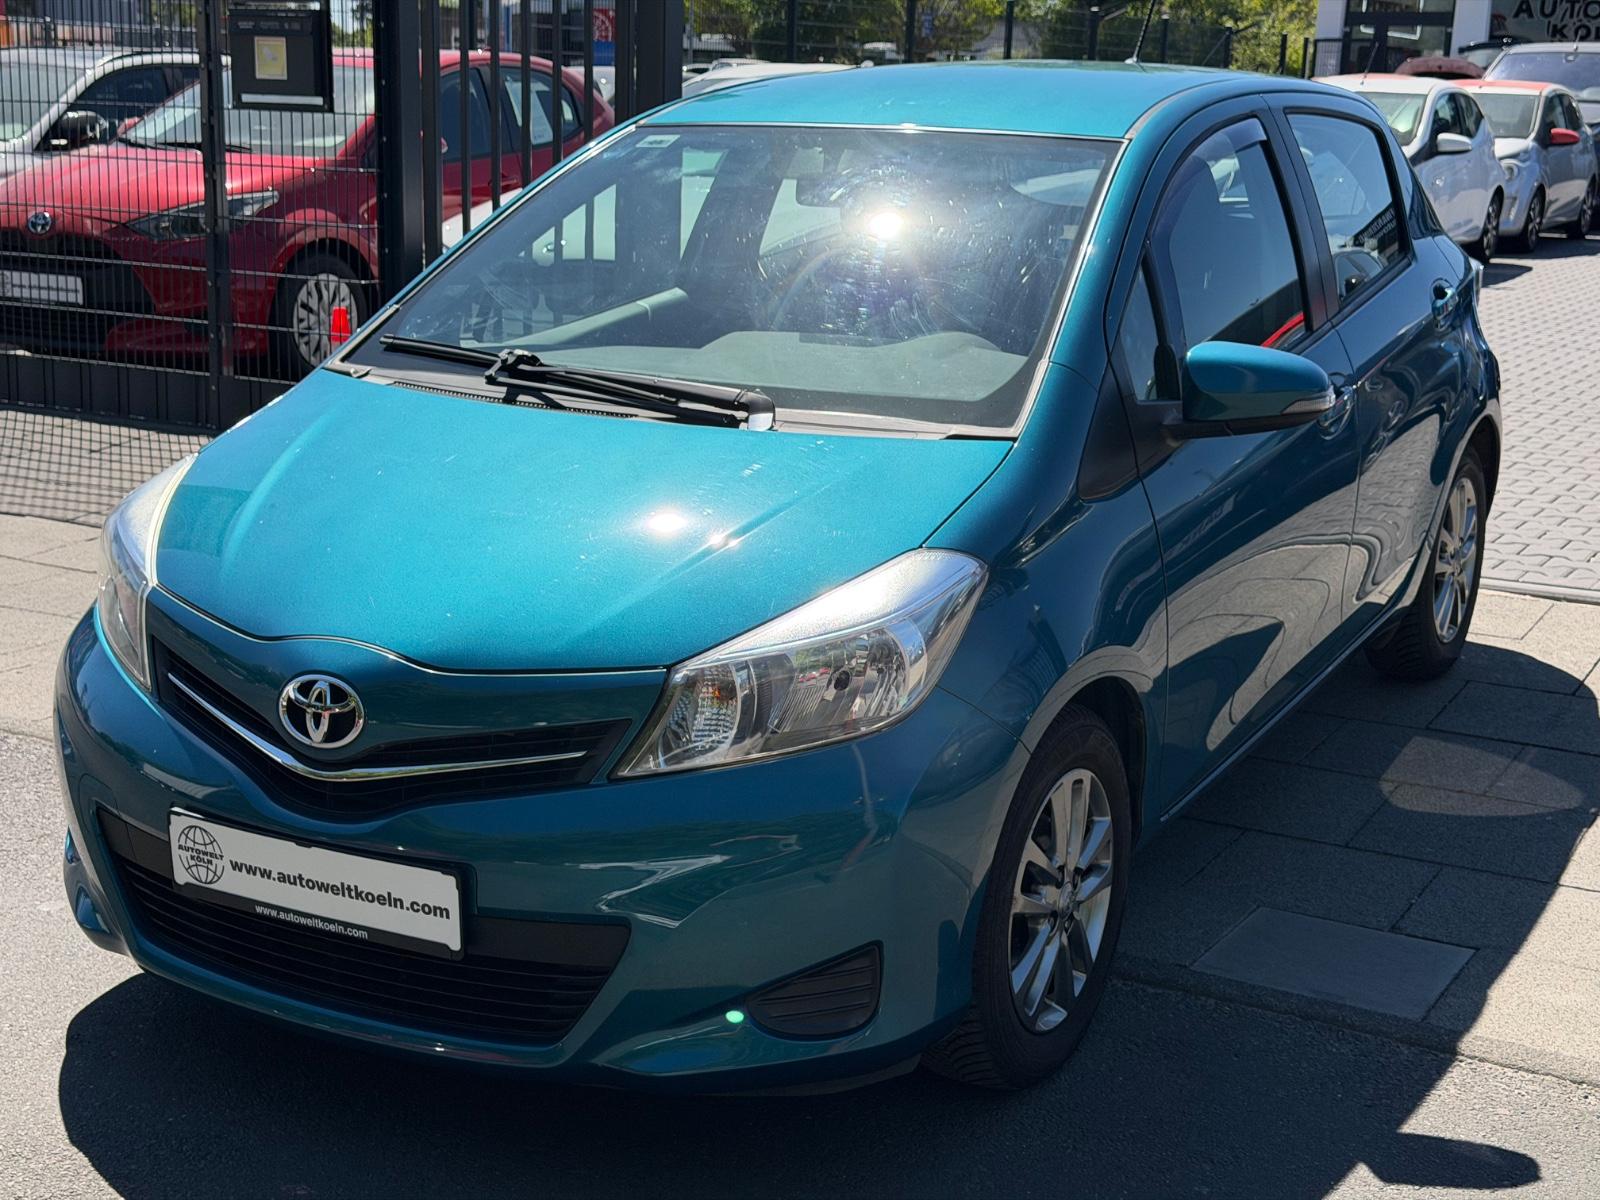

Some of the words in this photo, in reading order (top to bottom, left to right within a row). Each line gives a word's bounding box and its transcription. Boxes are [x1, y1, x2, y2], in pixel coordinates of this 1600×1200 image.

[178, 844, 224, 861] AUTOWELT
[190, 854, 213, 866] KÖLN
[229, 859, 451, 920] www.autoweltkoeln.com
[255, 904, 369, 940] www.autoweltkoeln.com
